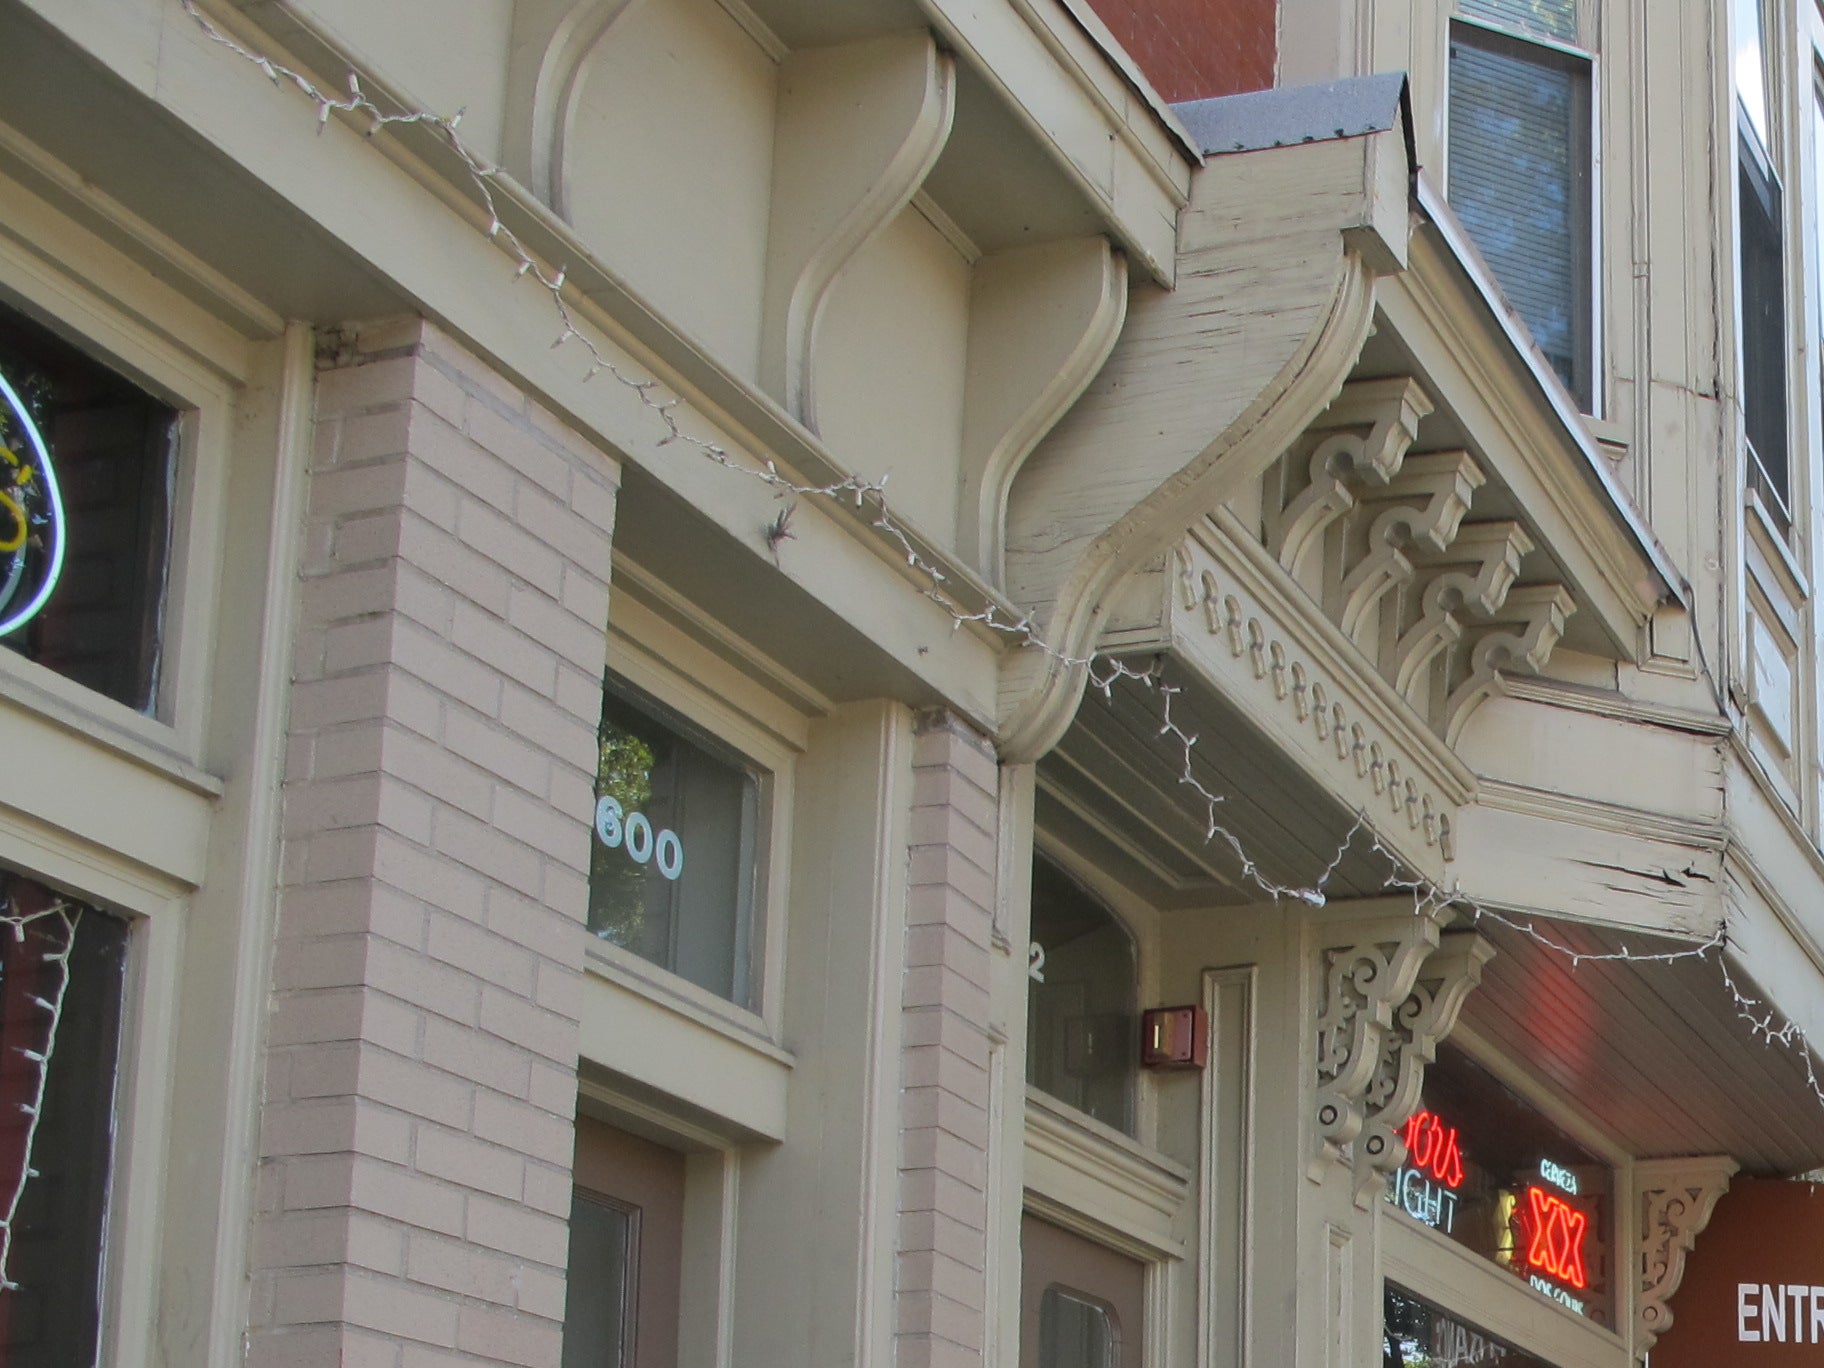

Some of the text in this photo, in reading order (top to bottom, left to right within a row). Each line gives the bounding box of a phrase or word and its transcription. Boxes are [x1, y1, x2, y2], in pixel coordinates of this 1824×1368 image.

[596, 795, 684, 880] 600
[1384, 1167, 1458, 1234] IGHT
[1528, 1185, 1588, 1290] XX
